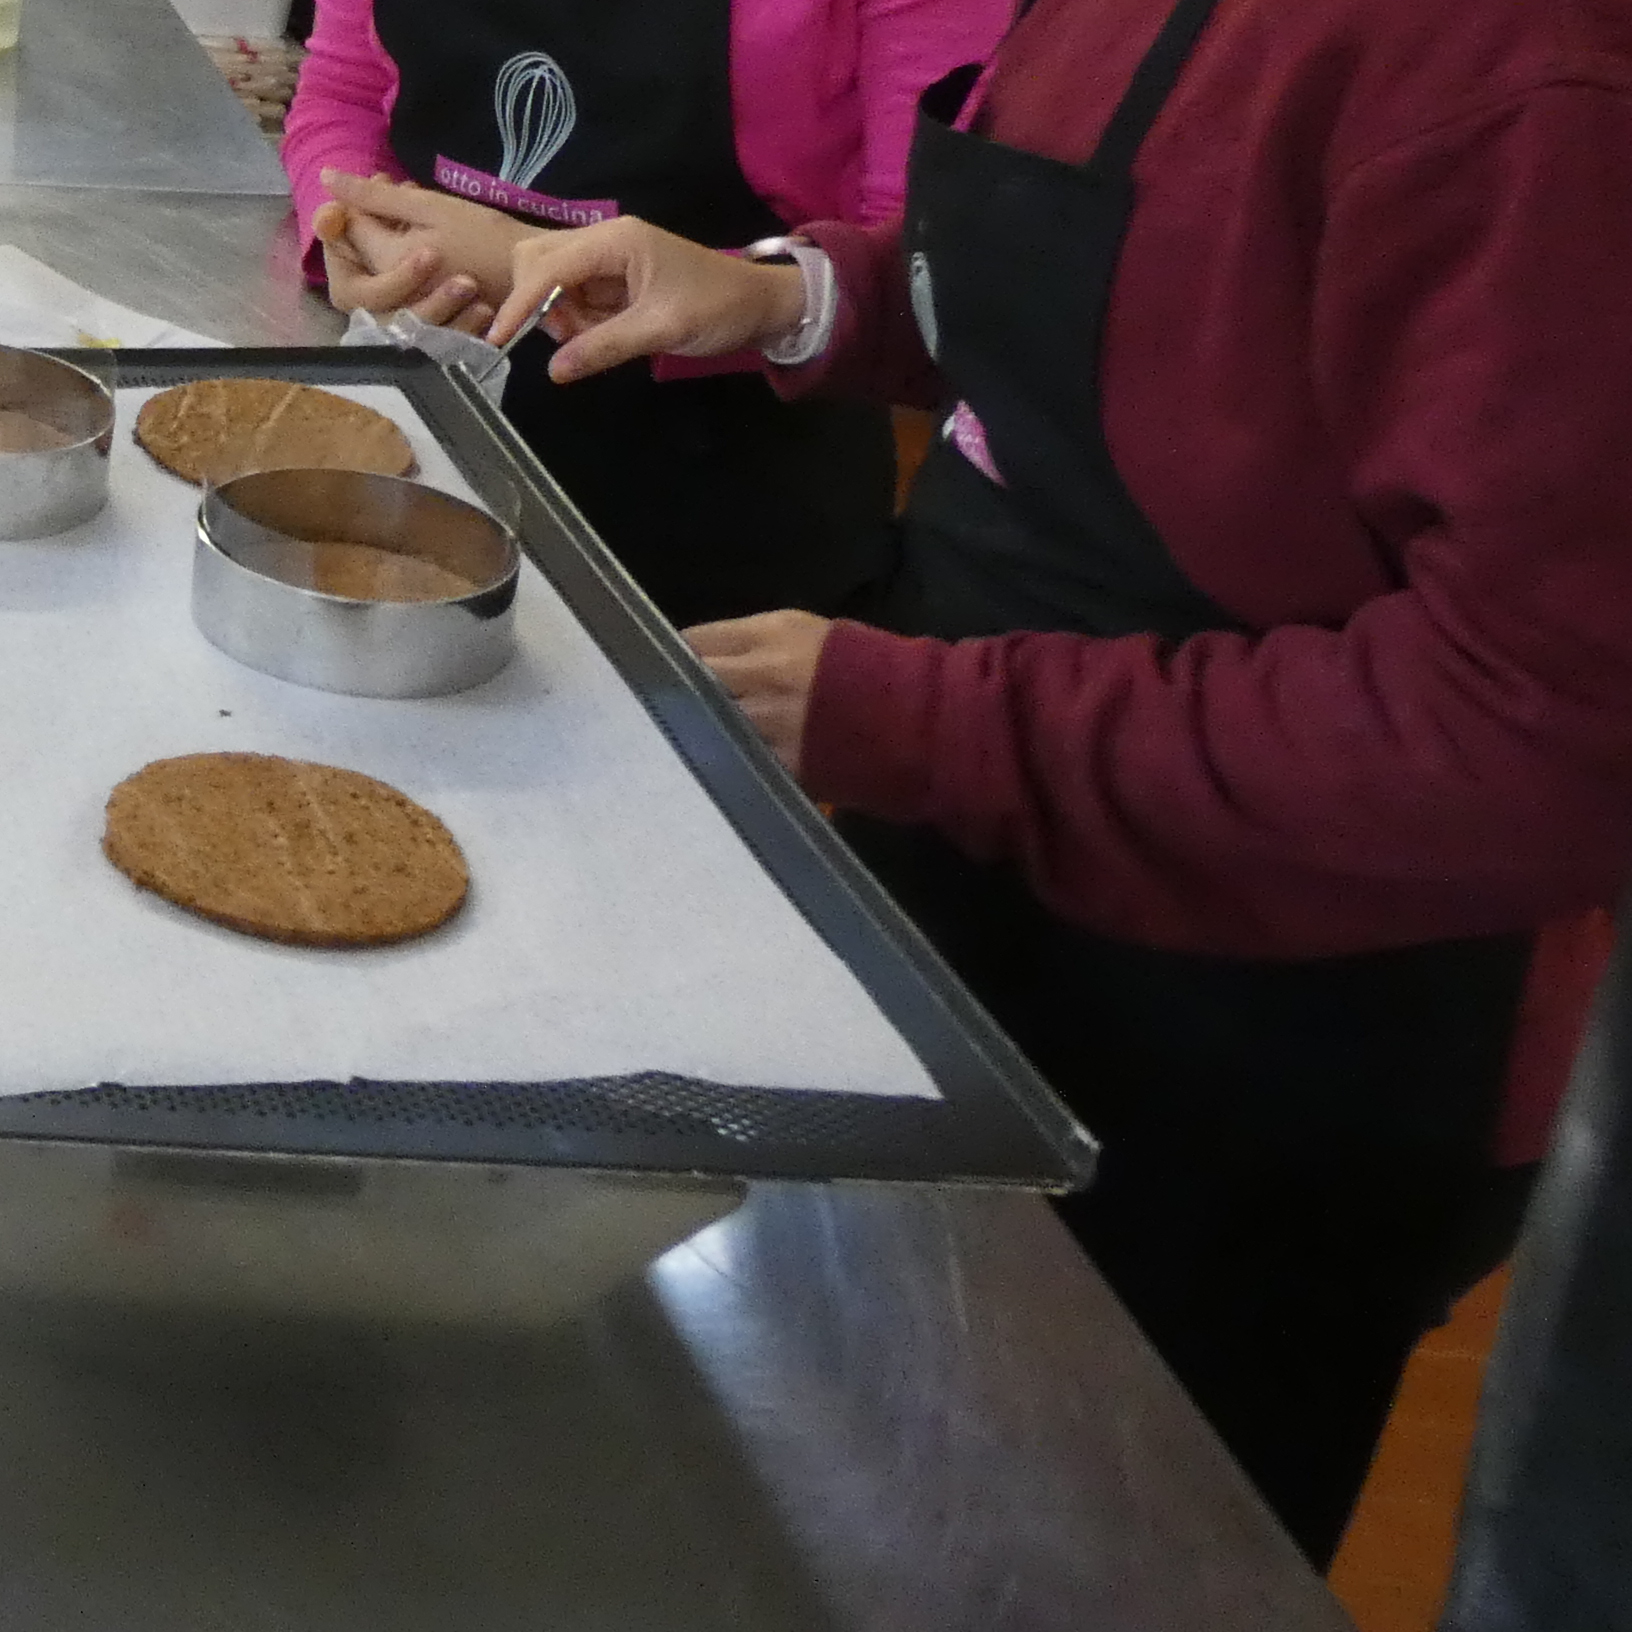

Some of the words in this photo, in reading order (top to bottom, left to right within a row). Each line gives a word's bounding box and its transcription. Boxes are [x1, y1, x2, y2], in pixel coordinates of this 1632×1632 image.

[440, 167, 482, 197] otto
[488, 179, 509, 205] in
[516, 198, 603, 225] cucina
